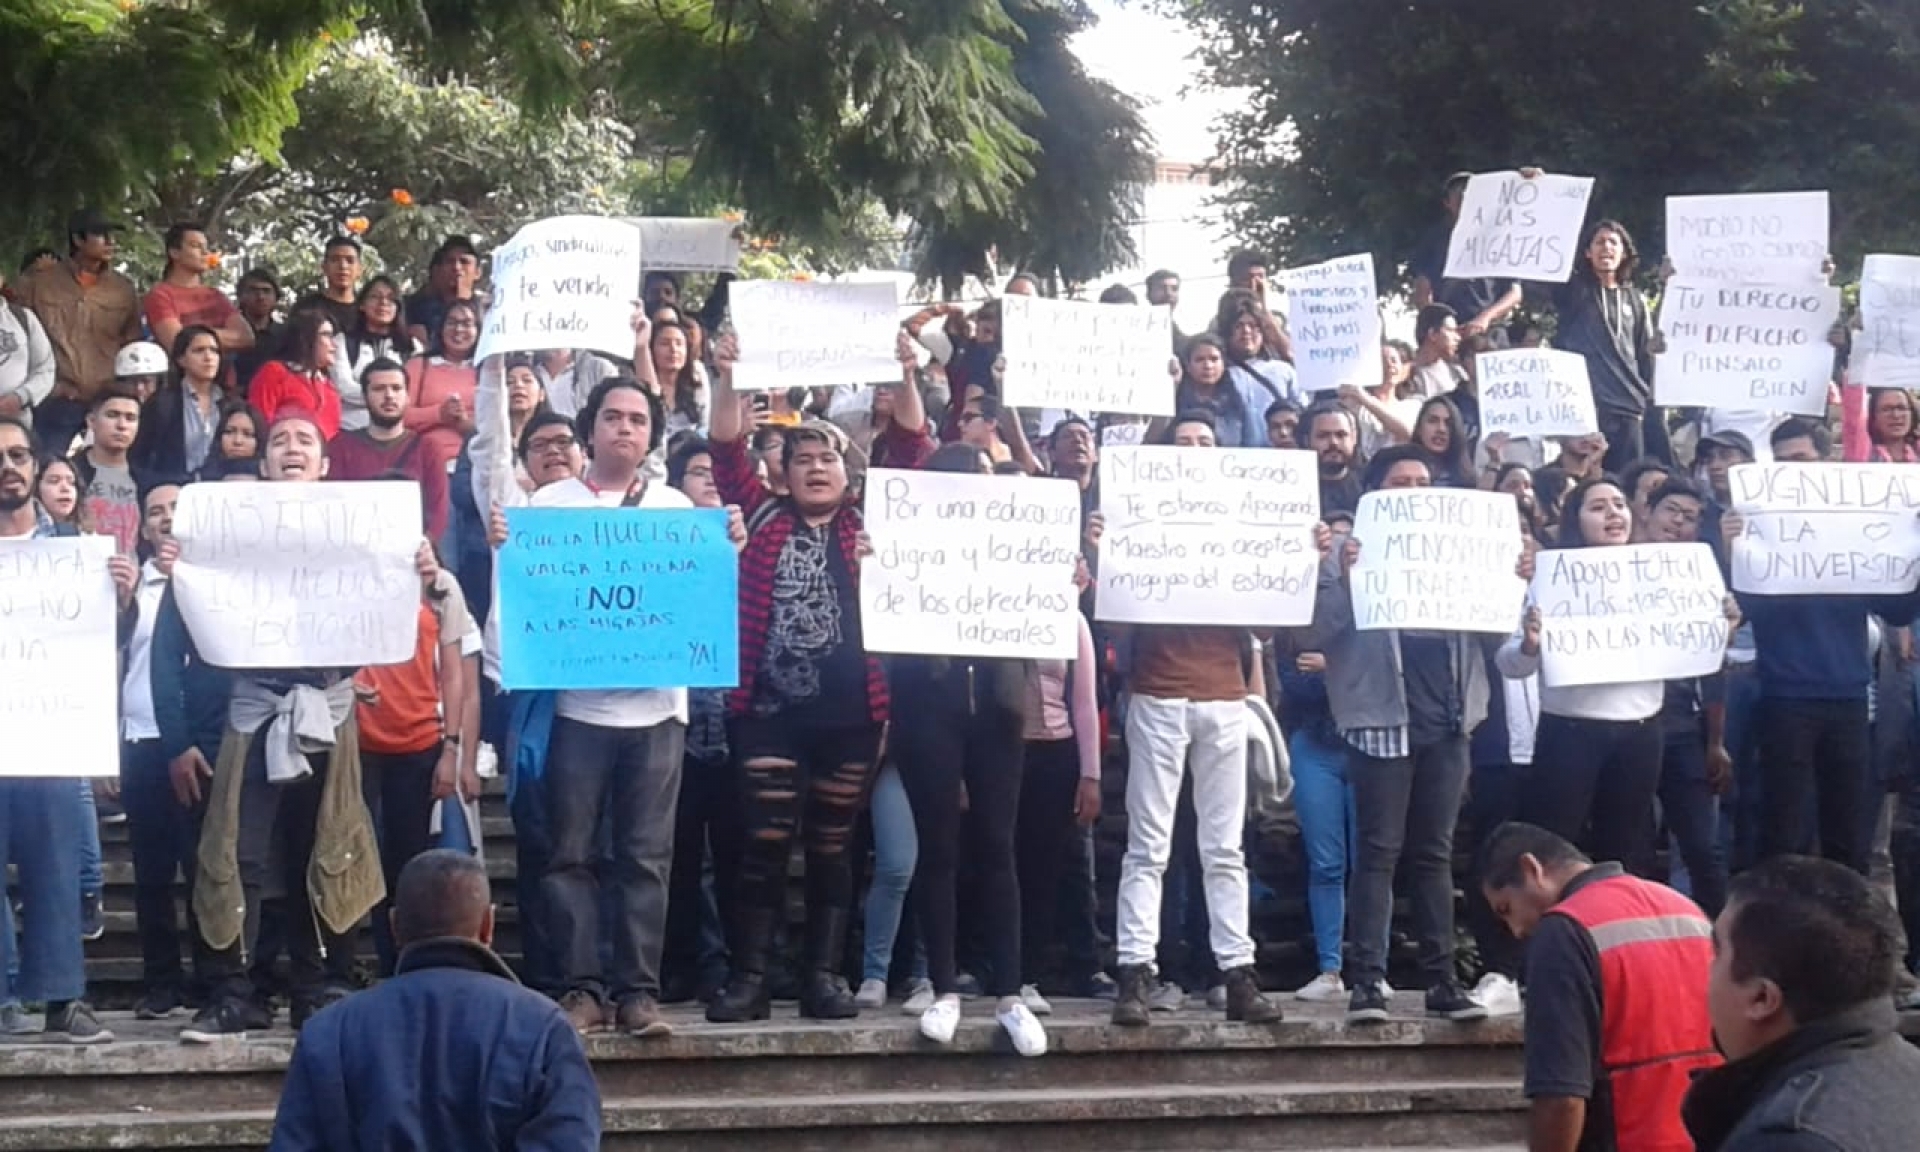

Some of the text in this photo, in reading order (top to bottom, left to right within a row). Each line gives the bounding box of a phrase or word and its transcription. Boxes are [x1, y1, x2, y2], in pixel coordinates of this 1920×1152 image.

[1498, 178, 1540, 206] NO
[1473, 206, 1483, 226] A
[1751, 214, 1784, 237] NO
[1455, 234, 1564, 274] MIGAJAS
[519, 276, 544, 303] te
[1675, 285, 1823, 313] TU DERECHO
[489, 310, 590, 335] al Estado
[1671, 320, 1809, 347] MI DERECHO
[1682, 350, 1783, 374] PIENSALO
[1749, 377, 1808, 399] BIEN
[1105, 423, 1138, 442] NO
[1111, 450, 1207, 484] Maestro
[884, 476, 924, 520] Por
[936, 498, 976, 520] una
[1117, 492, 1147, 519] Te
[1157, 488, 1229, 517] estamos
[1373, 493, 1475, 527] MAESTRO
[594, 517, 710, 547] HUELGA
[1745, 516, 1816, 543] A LA
[880, 539, 946, 581] digna
[961, 547, 979, 572] y
[987, 533, 1013, 563] la
[1109, 531, 1303, 559] Maestro no aceptes
[525, 560, 590, 577] VALGA
[605, 560, 633, 574] LA
[1193, 566, 1219, 590] del
[1364, 569, 1389, 596] TU
[1551, 548, 1704, 600] Apoyo total
[39, 588, 83, 622] NO
[873, 583, 1070, 616] de los derechos
[1417, 599, 1431, 619] A
[1550, 599, 1573, 618] a
[524, 612, 676, 633] A LAS MIGAJAS
[957, 616, 1058, 646] laborales
[1545, 629, 1579, 656] NO
[1586, 627, 1601, 649] A
[687, 641, 719, 673] YA!
